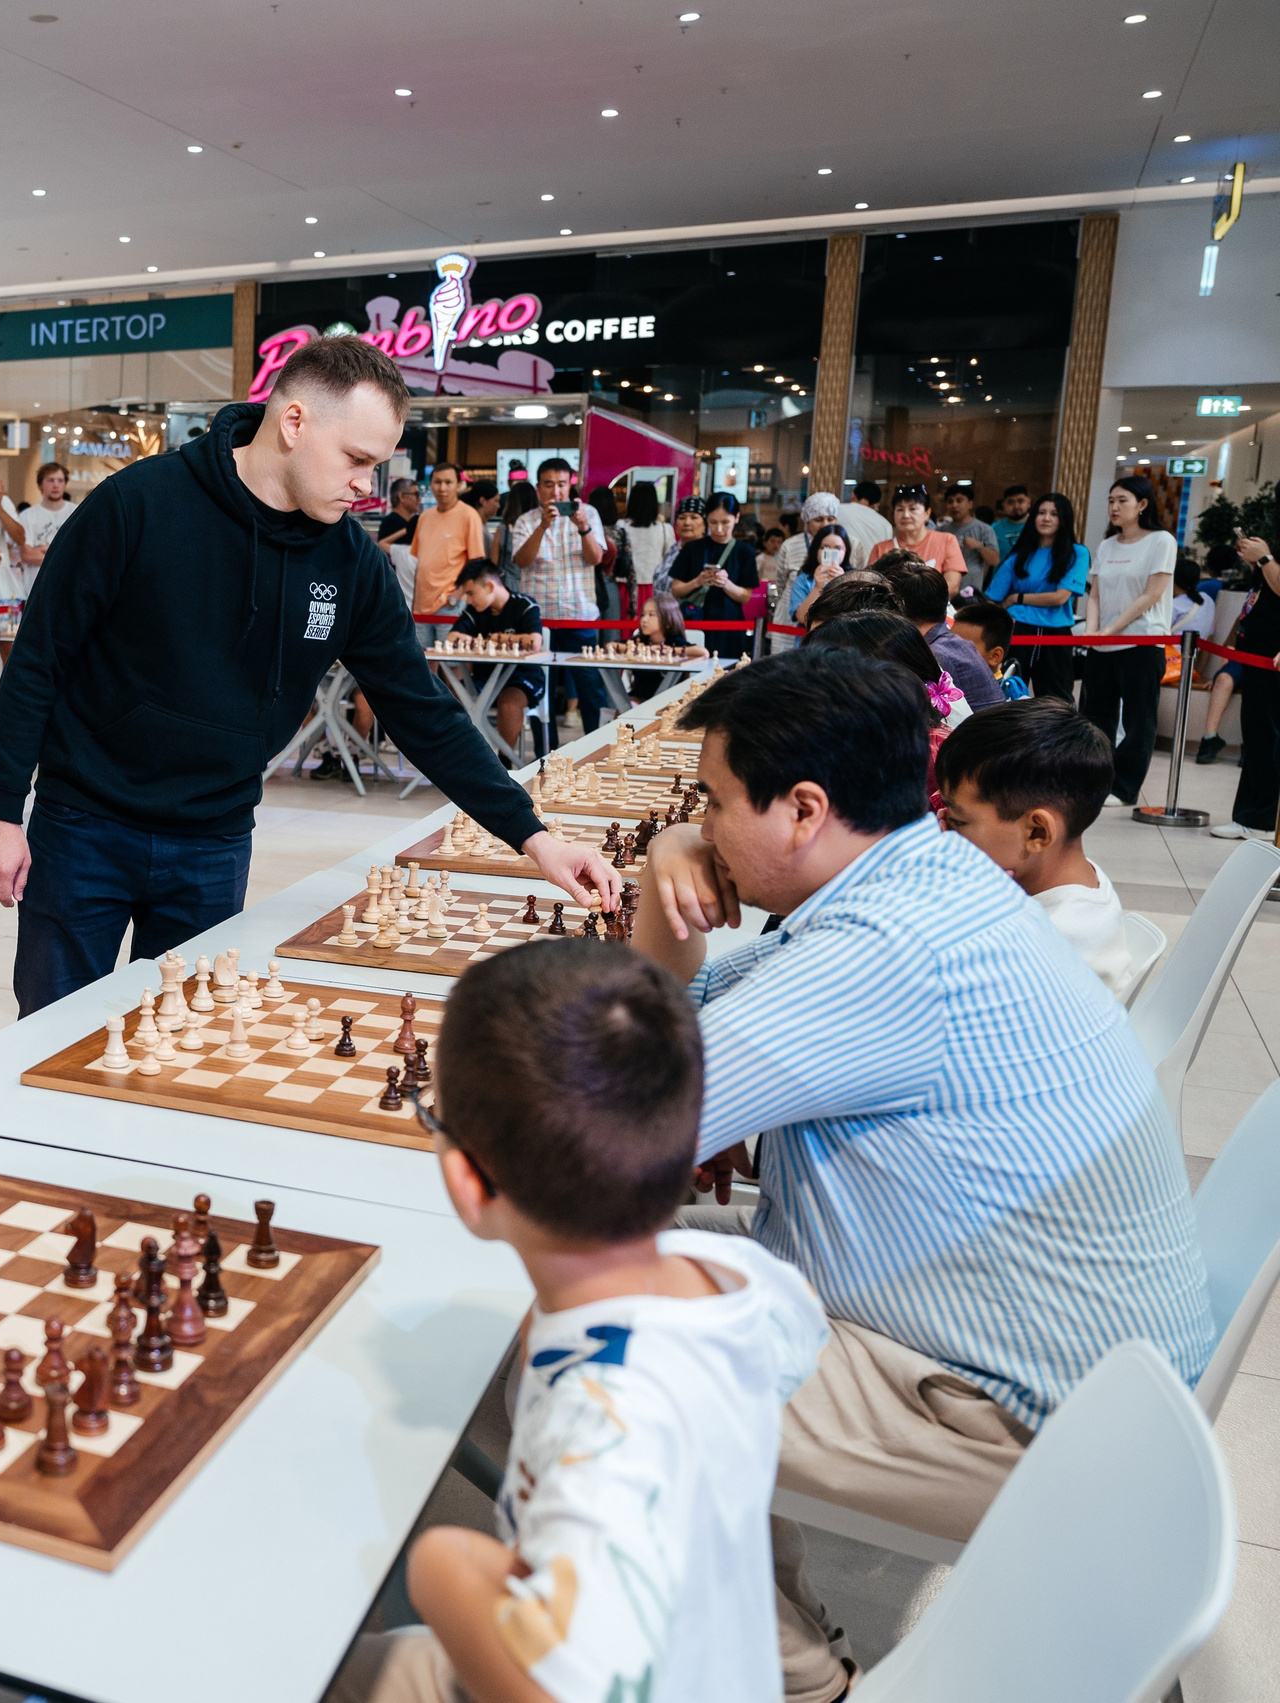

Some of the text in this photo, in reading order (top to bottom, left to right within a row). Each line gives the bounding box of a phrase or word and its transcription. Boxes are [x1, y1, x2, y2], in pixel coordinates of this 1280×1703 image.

[30, 313, 166, 346] INTERTOP
[545, 305, 656, 343] COFFEE
[309, 601, 336, 614] OLYMPIC
[307, 613, 335, 626] ESPORTS
[306, 626, 330, 638] SERIES
